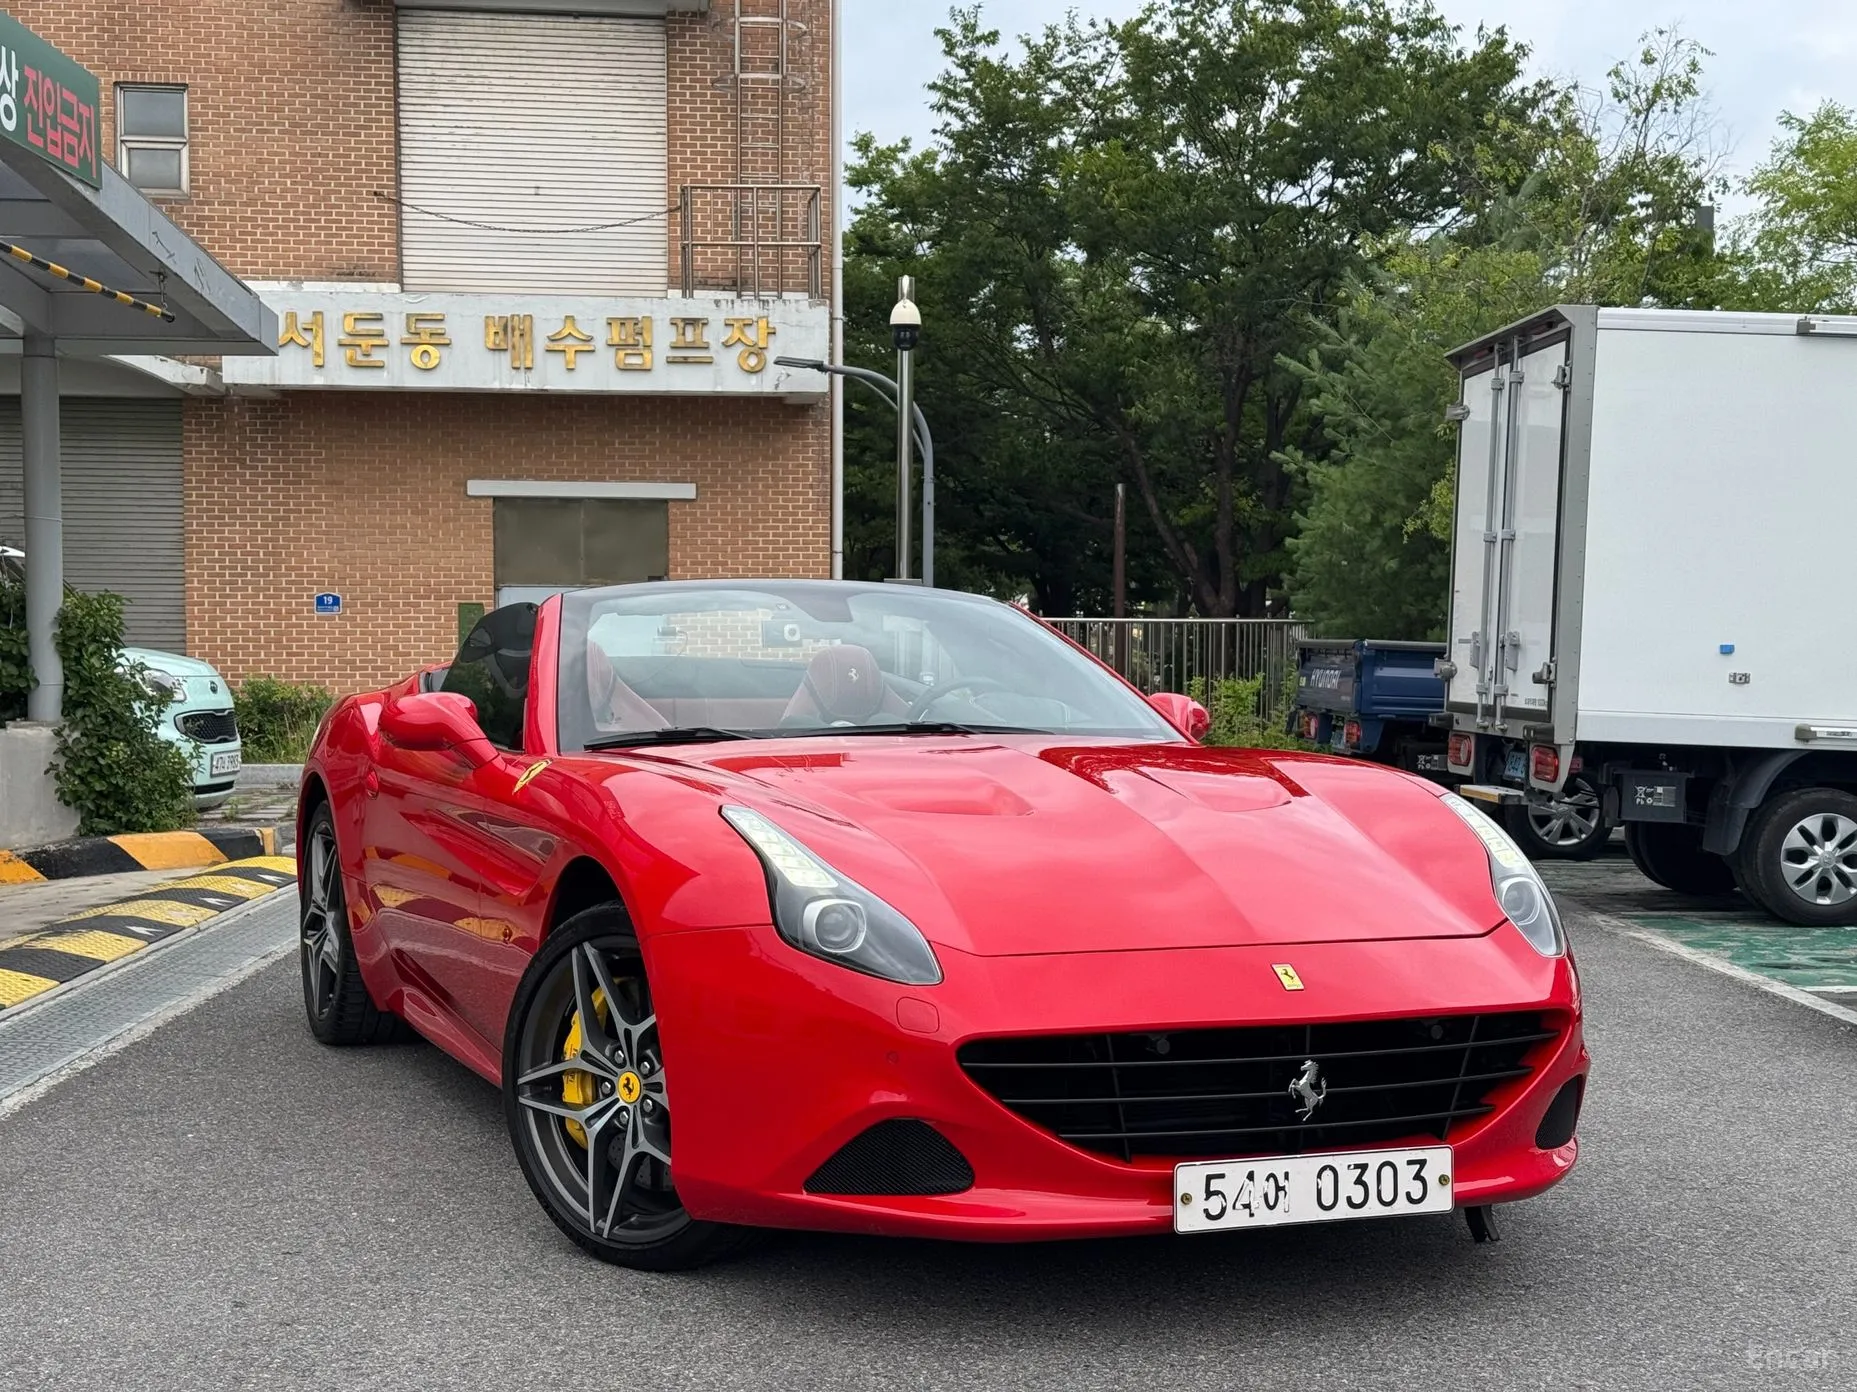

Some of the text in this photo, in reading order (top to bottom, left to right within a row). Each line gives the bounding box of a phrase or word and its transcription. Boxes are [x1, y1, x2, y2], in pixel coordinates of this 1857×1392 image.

[23, 63, 97, 179] 진입금지
[279, 311, 776, 373] 서둔동 배수펌프장
[323, 596, 333, 605] 19
[1309, 668, 1341, 689] HYUNDAI
[1315, 1158, 1429, 1212] 0303
